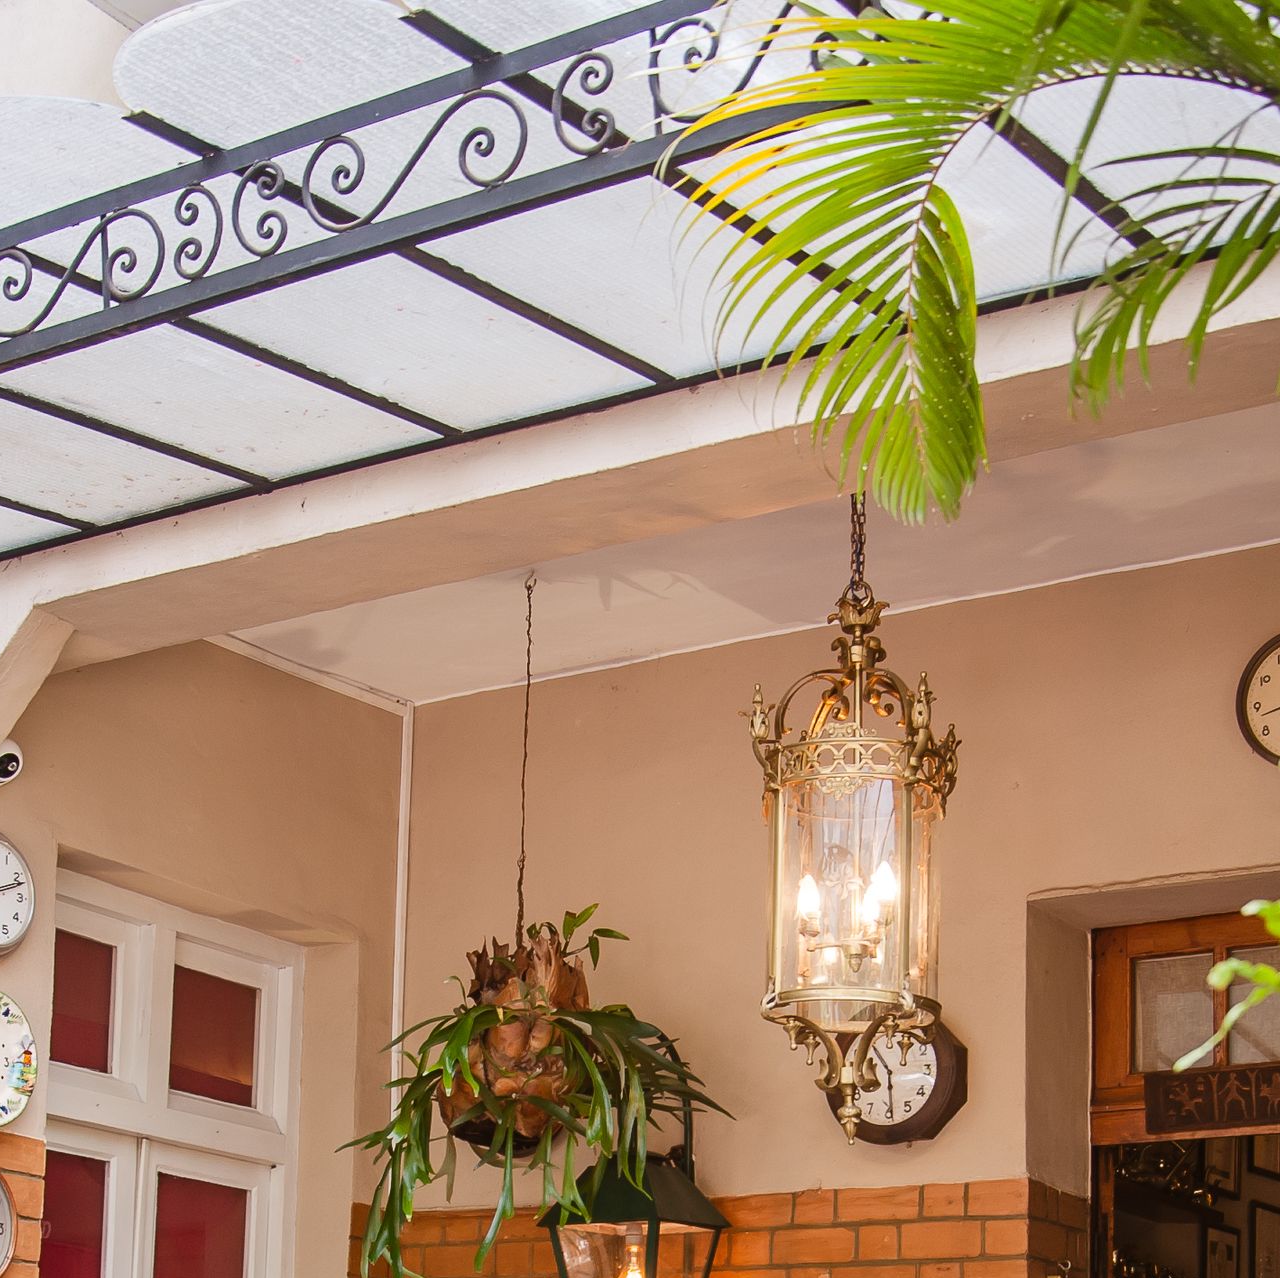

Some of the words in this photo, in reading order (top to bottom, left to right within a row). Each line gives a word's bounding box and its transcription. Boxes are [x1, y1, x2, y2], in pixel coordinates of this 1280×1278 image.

[1260, 674, 1271, 686] 10
[1253, 701, 1262, 712] 9
[1262, 725, 1270, 736] 8
[16, 893, 24, 903] 3
[13, 912, 19, 922] 4
[2, 925, 9, 935] 5
[4, 1058, 9, 1067] 3
[923, 1064, 931, 1075] 3
[916, 1085, 926, 1097] 4
[866, 1103, 874, 1115] 7
[903, 1101, 912, 1113] 5
